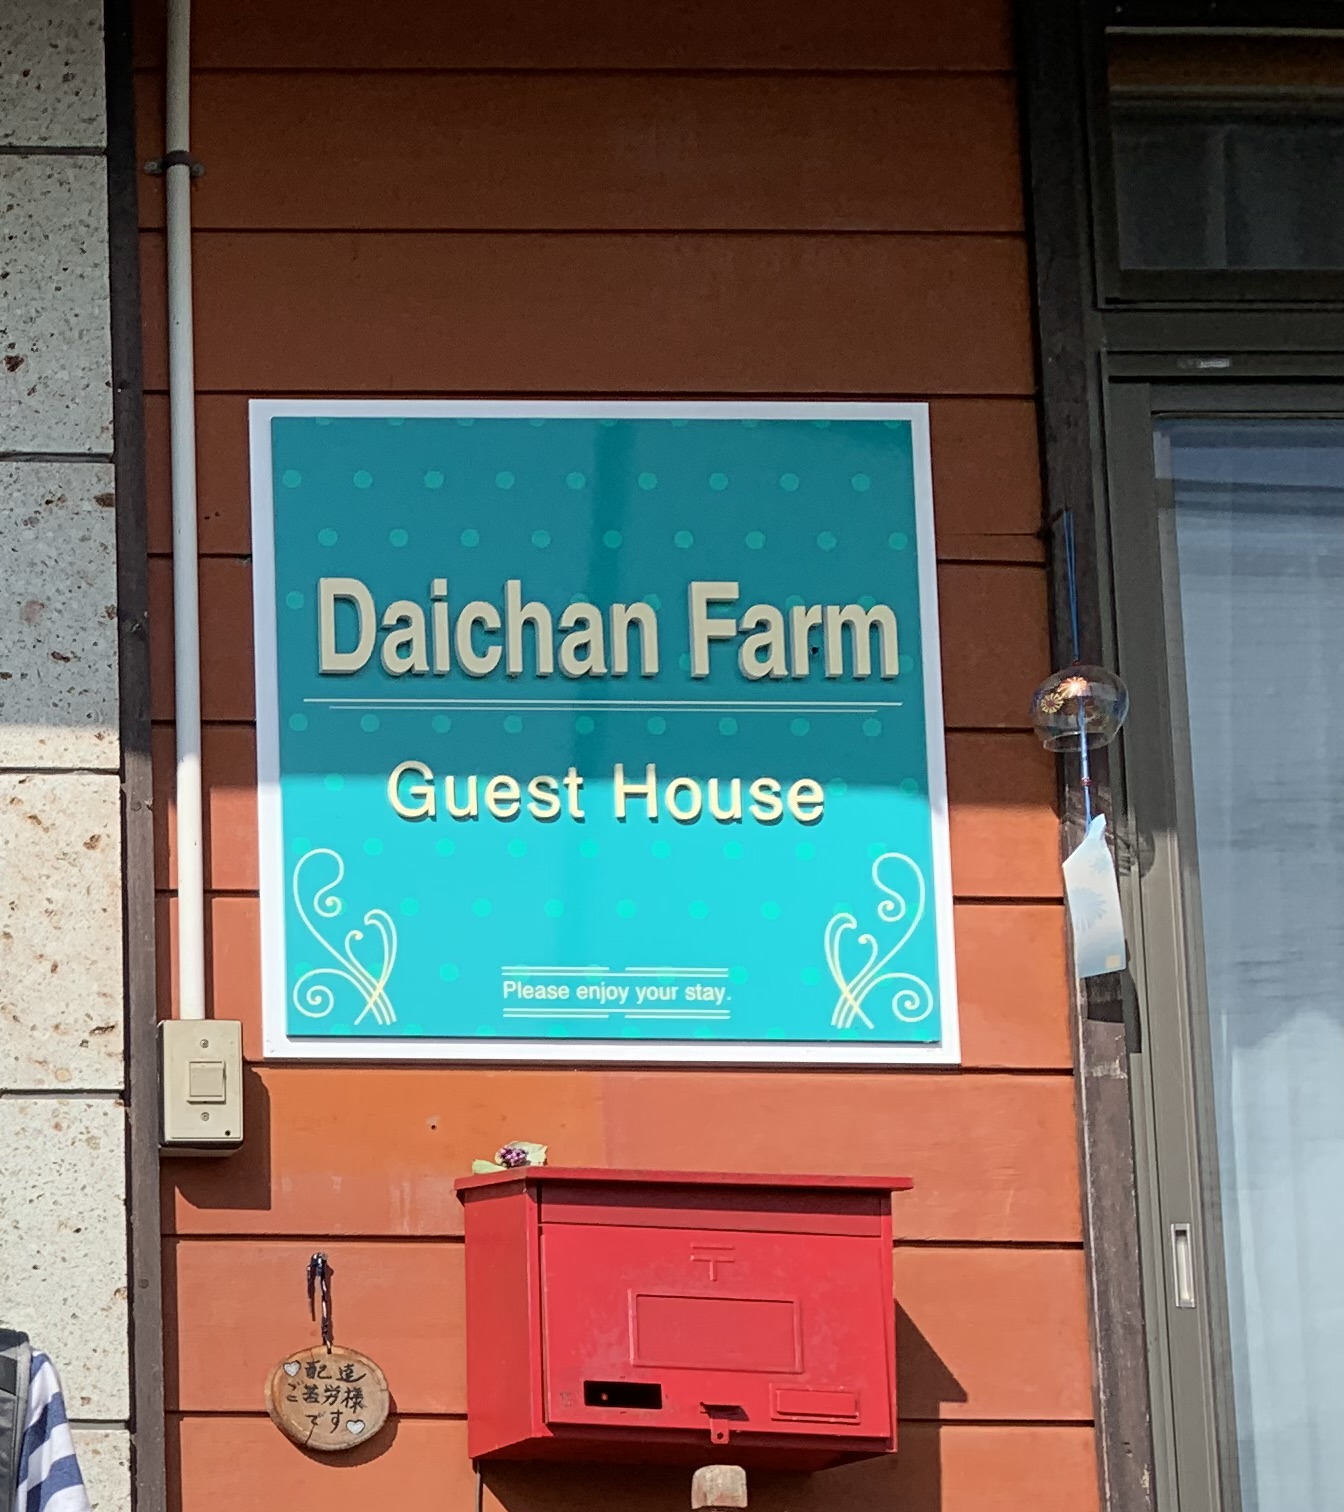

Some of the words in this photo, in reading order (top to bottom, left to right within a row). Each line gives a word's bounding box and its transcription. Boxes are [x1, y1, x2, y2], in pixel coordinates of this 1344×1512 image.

[317, 577, 658, 678] Daichan
[688, 580, 900, 680] Farm
[387, 761, 584, 822] Guest
[613, 763, 825, 824] House
[502, 980, 570, 1000] Please
[576, 982, 630, 1005] enjoy
[635, 984, 679, 1005] your
[685, 984, 732, 1006] stay.
[304, 1360, 367, 1383] 配達
[305, 1409, 344, 1434] です
